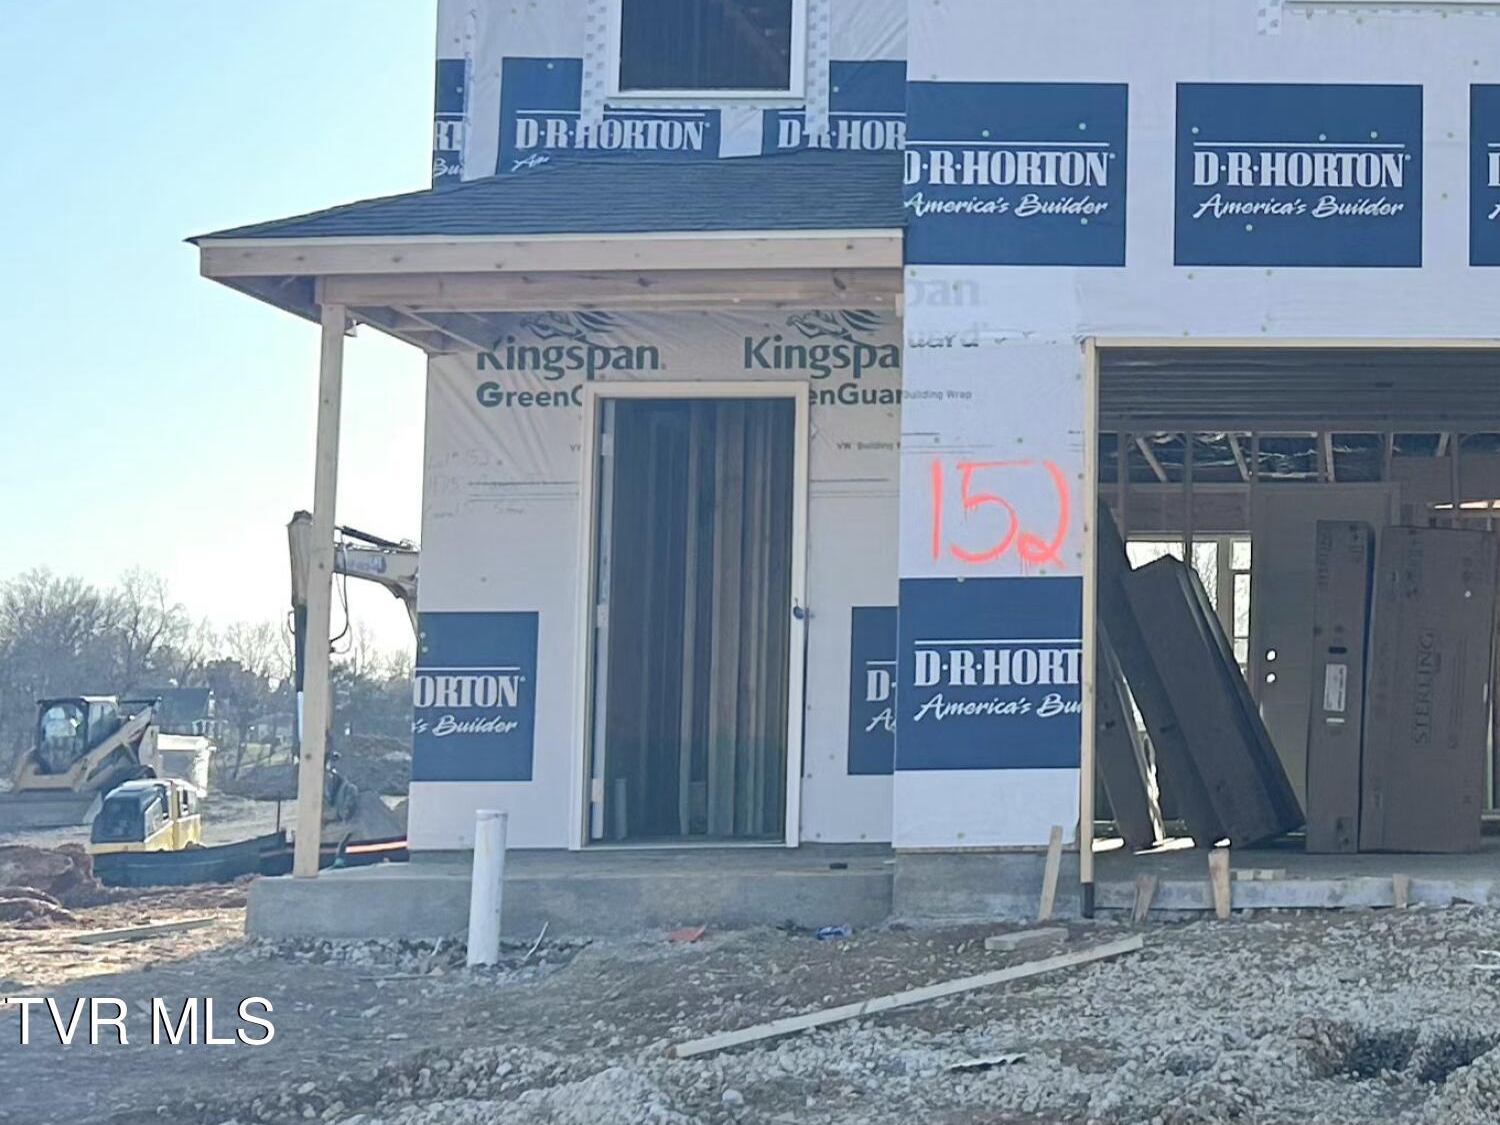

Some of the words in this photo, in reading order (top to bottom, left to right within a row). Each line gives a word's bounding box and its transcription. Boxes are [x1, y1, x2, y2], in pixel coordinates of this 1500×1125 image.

[904, 192, 1010, 217] America's
[1015, 194, 1107, 217] Builder
[1193, 193, 1307, 219] America's
[1311, 195, 1403, 218] Builder
[476, 335, 659, 380] Kingspan
[744, 335, 899, 379] Kingspa
[931, 458, 1070, 572] 152
[914, 649, 1082, 686] D·R·HORT
[413, 675, 520, 707] ORTON
[914, 694, 1031, 721] America's
[432, 715, 517, 736] Builder
